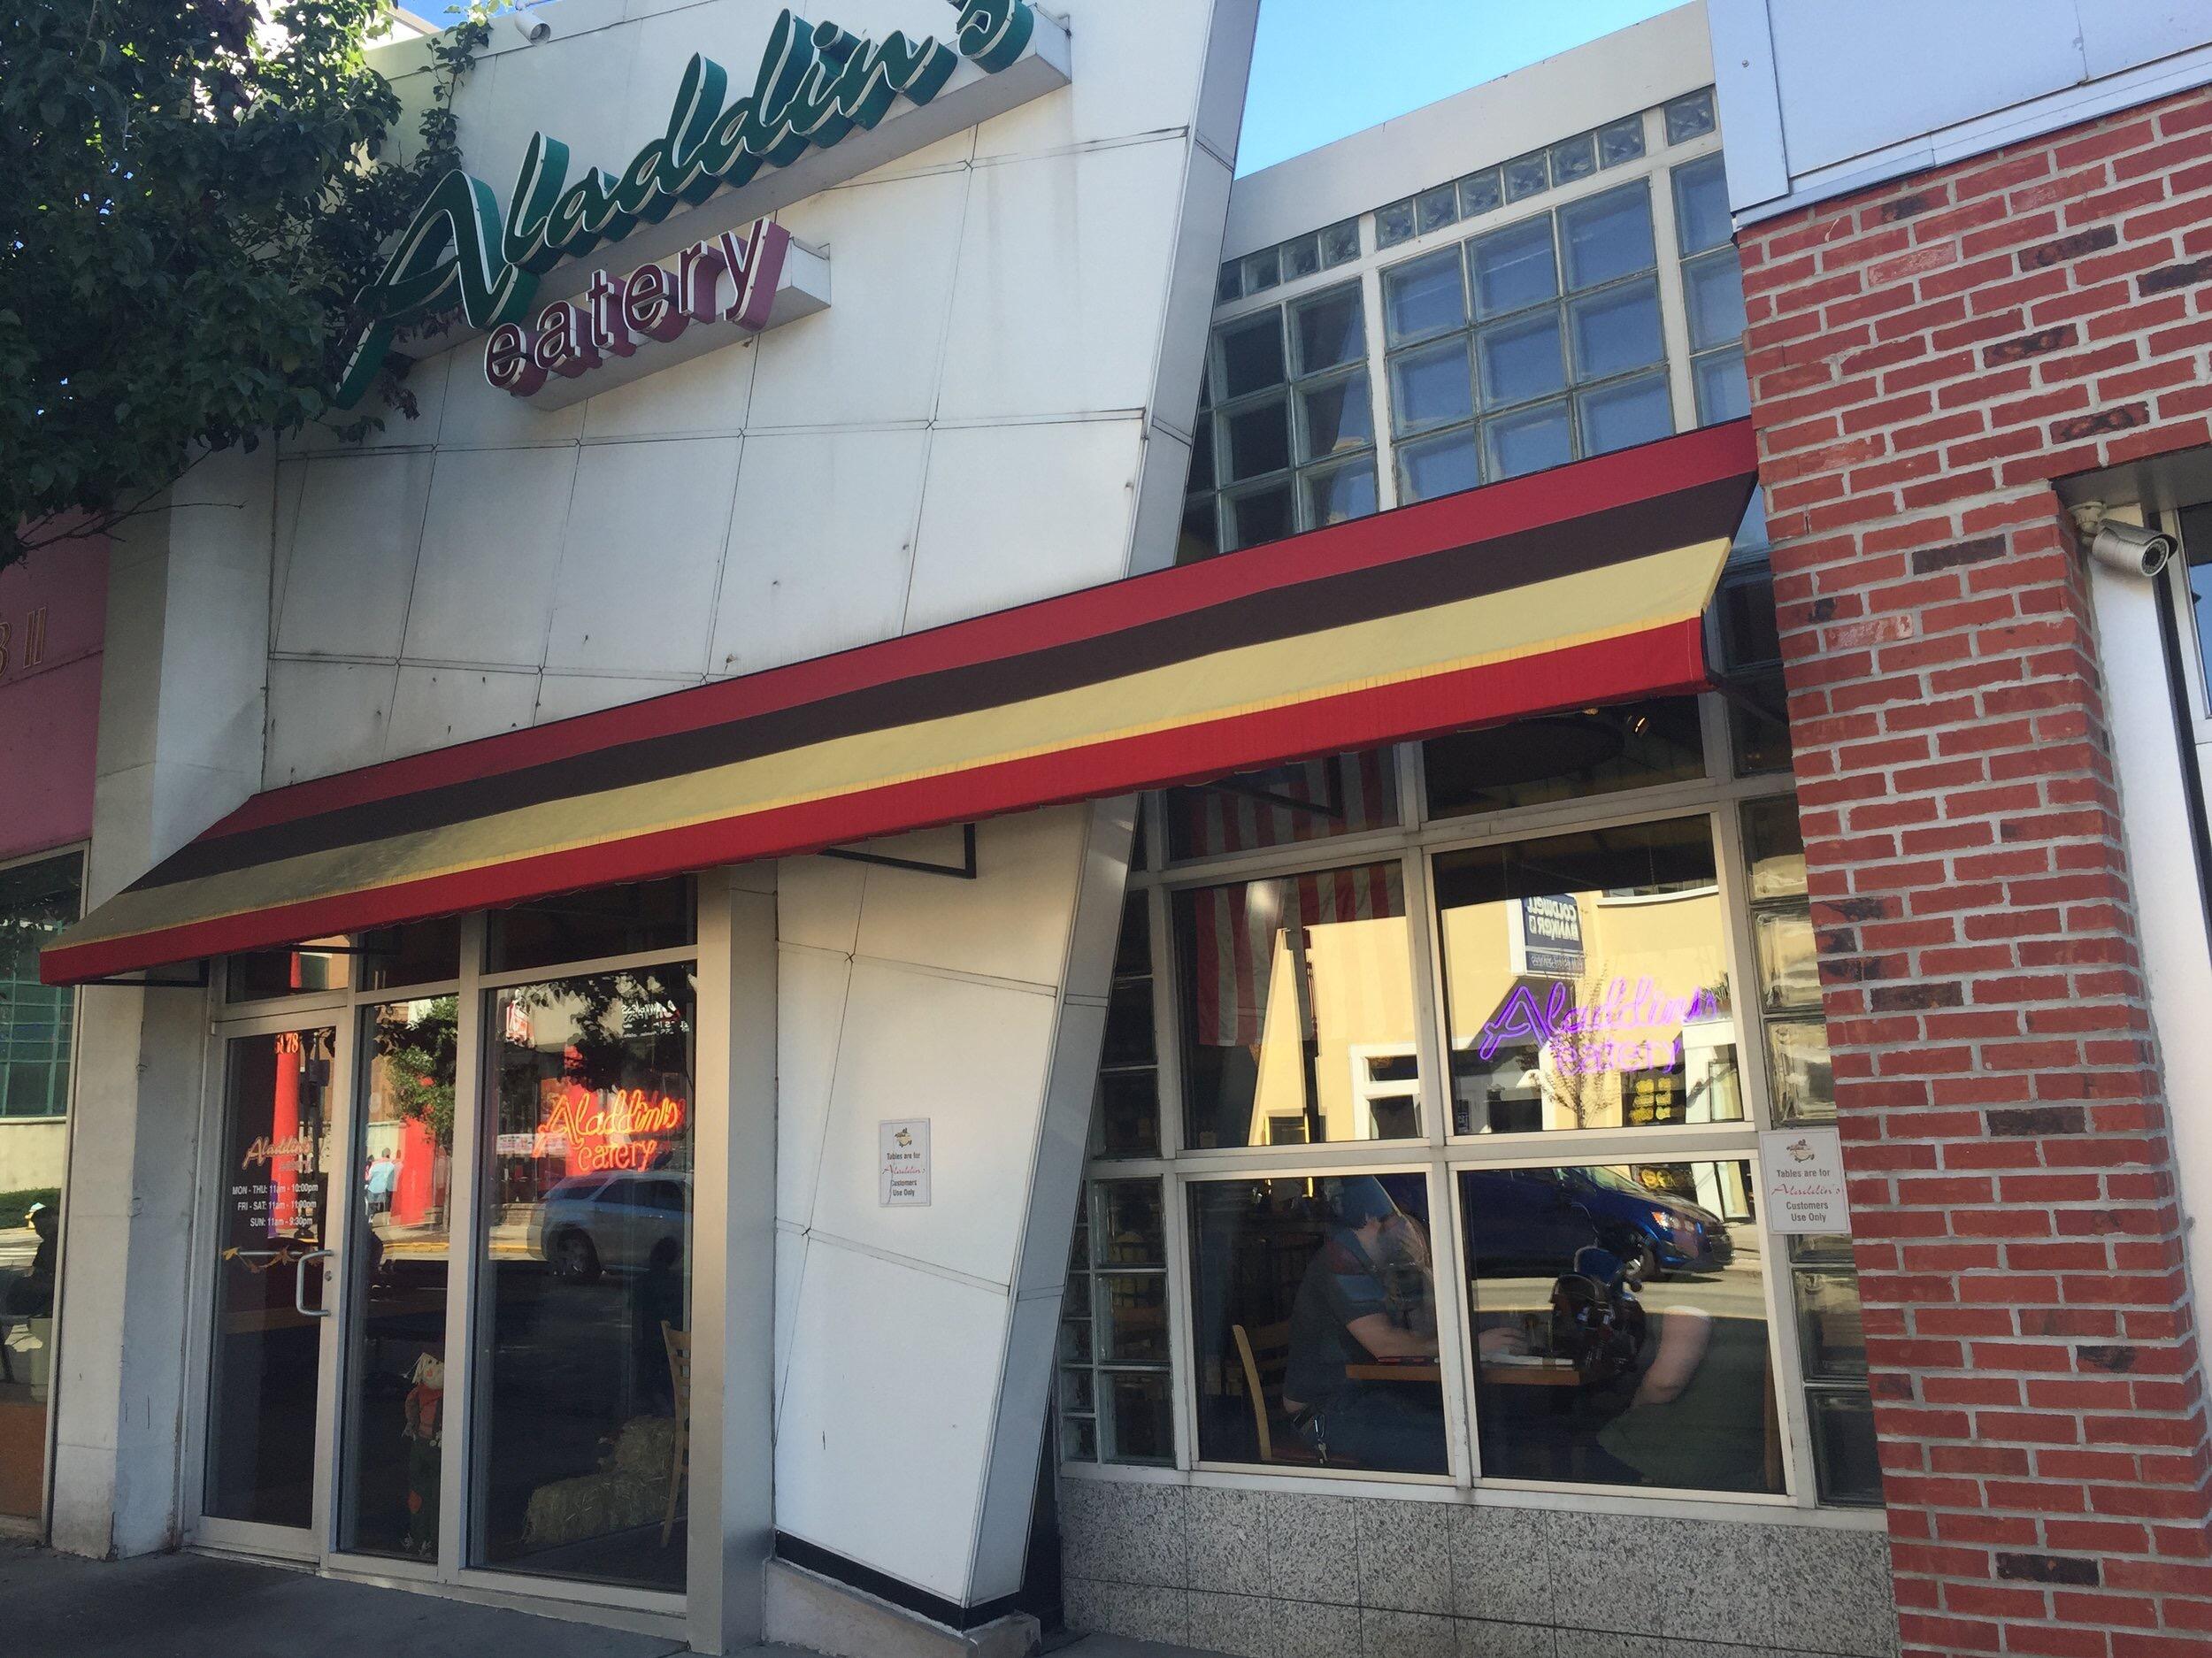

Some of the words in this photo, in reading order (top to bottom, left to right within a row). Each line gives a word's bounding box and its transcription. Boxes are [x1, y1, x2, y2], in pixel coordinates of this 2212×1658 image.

[334, 0, 1028, 407] Aladdins
[484, 218, 785, 395] eatery
[578, 1140, 657, 1172] eatery
[232, 1186, 248, 1195] MON
[252, 1186, 268, 1194] THU:
[270, 1185, 286, 1194] 11am
[237, 1201, 248, 1211] FRI
[1786, 1201, 1829, 1210] Customers
[250, 1218, 265, 1227] SUN:
[268, 1217, 284, 1226] 11am
[1791, 1213, 1807, 1222] Use
[1809, 1213, 1827, 1223] Only
